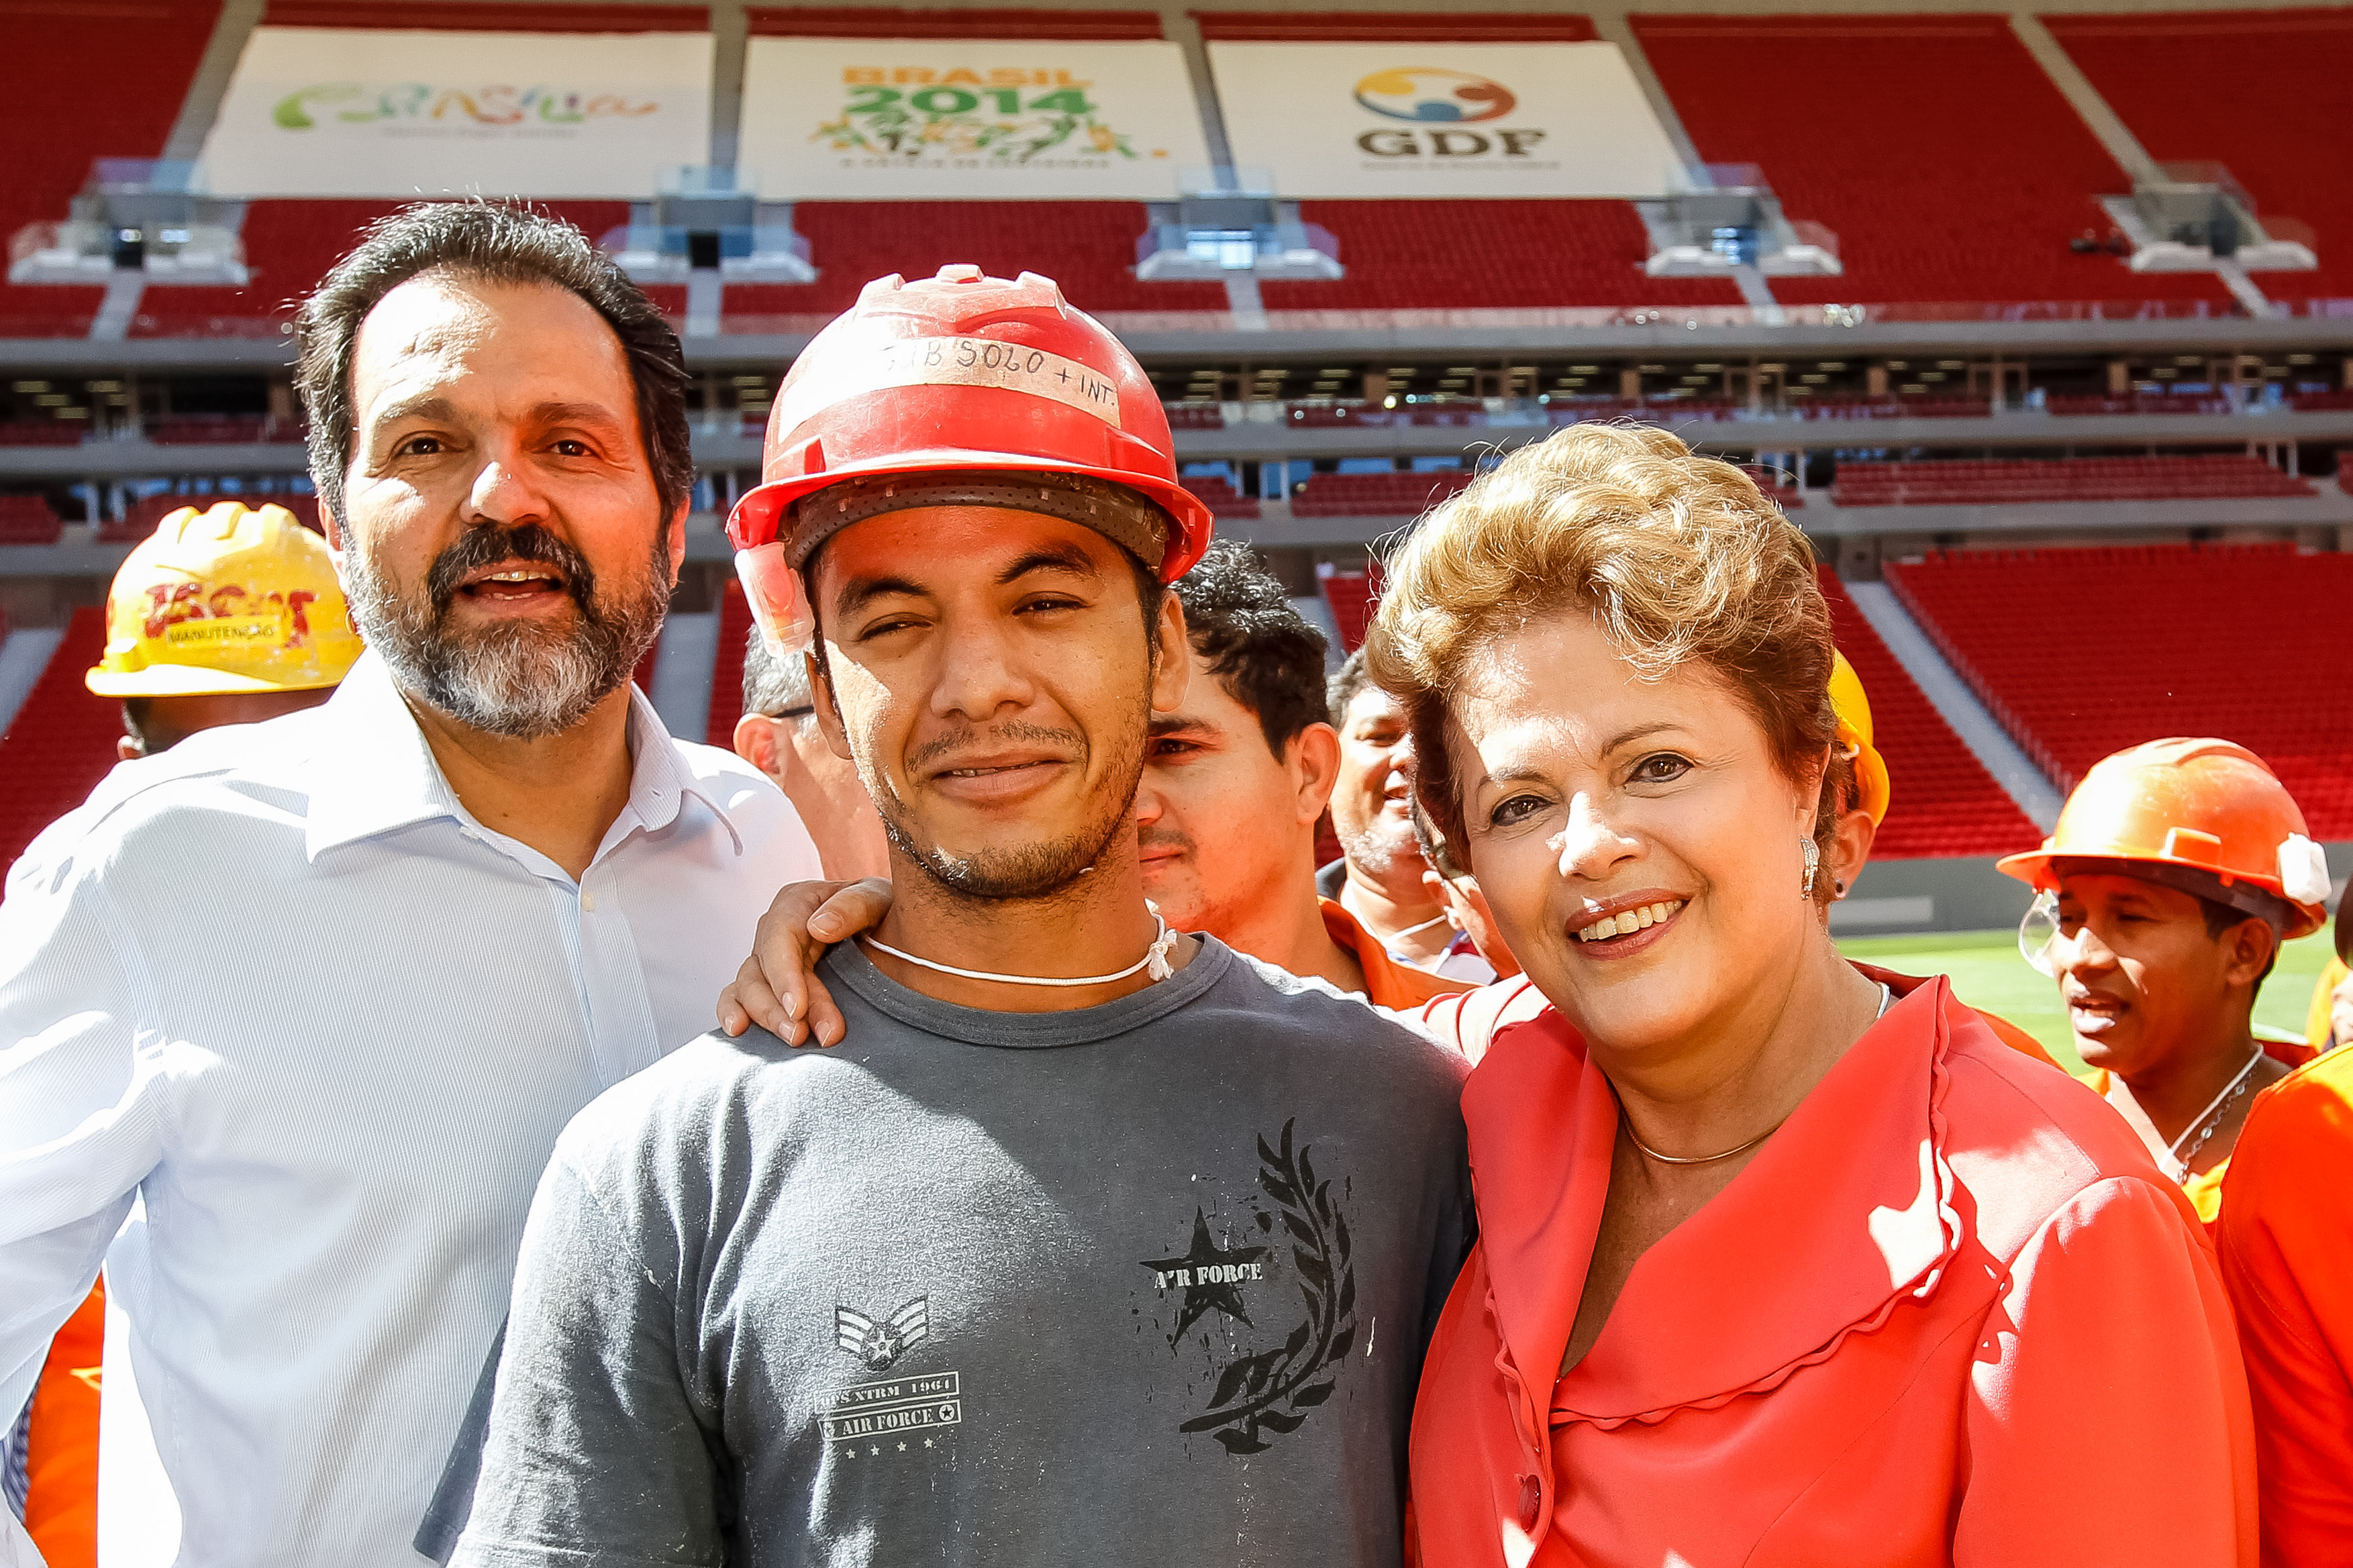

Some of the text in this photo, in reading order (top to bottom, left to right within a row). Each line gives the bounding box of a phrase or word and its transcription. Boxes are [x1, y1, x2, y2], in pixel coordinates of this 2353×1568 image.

[842, 66, 1094, 88] BRASIL
[844, 85, 1099, 114] 2014
[1355, 128, 1546, 157] GDF
[956, 339, 1046, 373] SOLO
[1079, 374, 1115, 407] INT.
[1196, 1263, 1263, 1286] FORCE
[854, 1386, 901, 1402] XTRM
[843, 1408, 934, 1435] AIR FORCE
